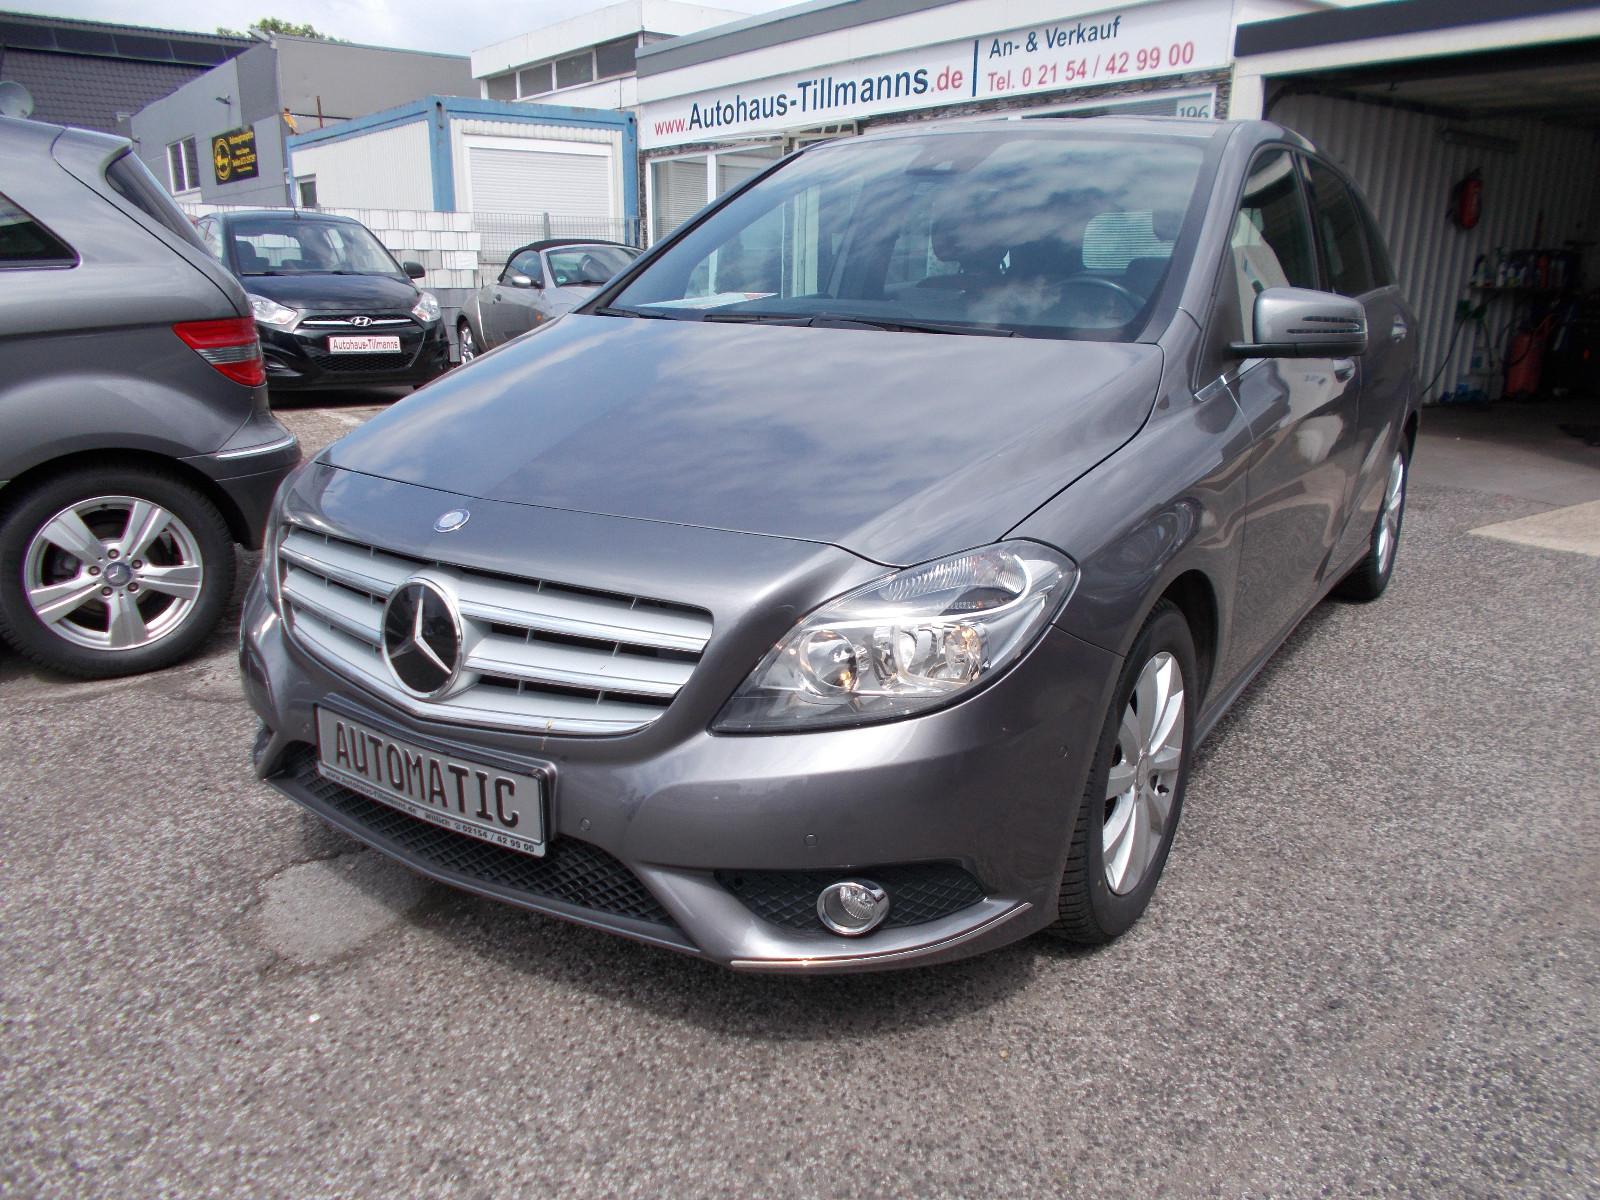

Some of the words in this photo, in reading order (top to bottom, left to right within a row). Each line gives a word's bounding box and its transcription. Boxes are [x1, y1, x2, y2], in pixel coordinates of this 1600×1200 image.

[989, 38, 1020, 59] An-
[1025, 31, 1038, 53] &
[1045, 15, 1121, 49] Verkauf
[987, 69, 1015, 92] Tel.
[1022, 66, 1032, 88] 0
[1038, 63, 1057, 85] 21
[1065, 57, 1087, 81] 54
[1092, 54, 1101, 78] /
[1105, 51, 1129, 74] 42
[1136, 47, 1160, 71] 99
[1168, 41, 1194, 66] 00
[655, 65, 963, 136] www.Autohaus-Tillmanns.de
[336, 721, 519, 828] AUTOMATIC
[463, 825, 488, 838] 02154
